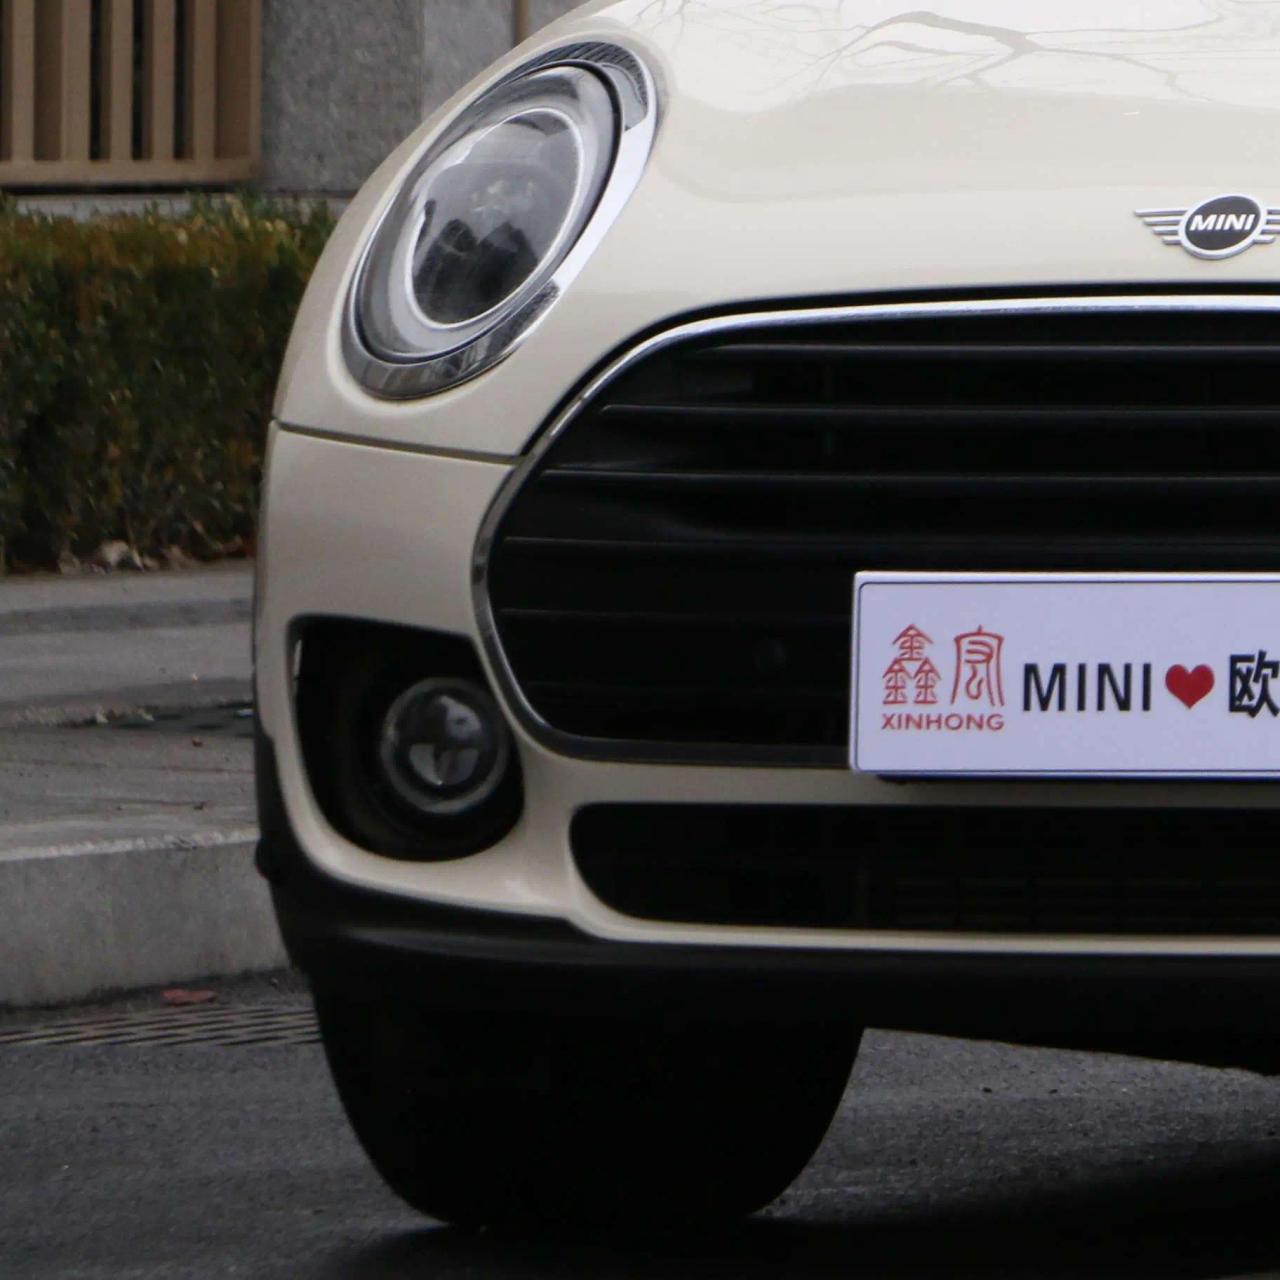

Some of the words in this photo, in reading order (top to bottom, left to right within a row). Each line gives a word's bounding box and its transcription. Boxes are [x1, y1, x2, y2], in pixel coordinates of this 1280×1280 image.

[1189, 213, 1255, 231] MINI
[1022, 663, 1152, 712] MINI
[881, 712, 1004, 731] XINHONG
